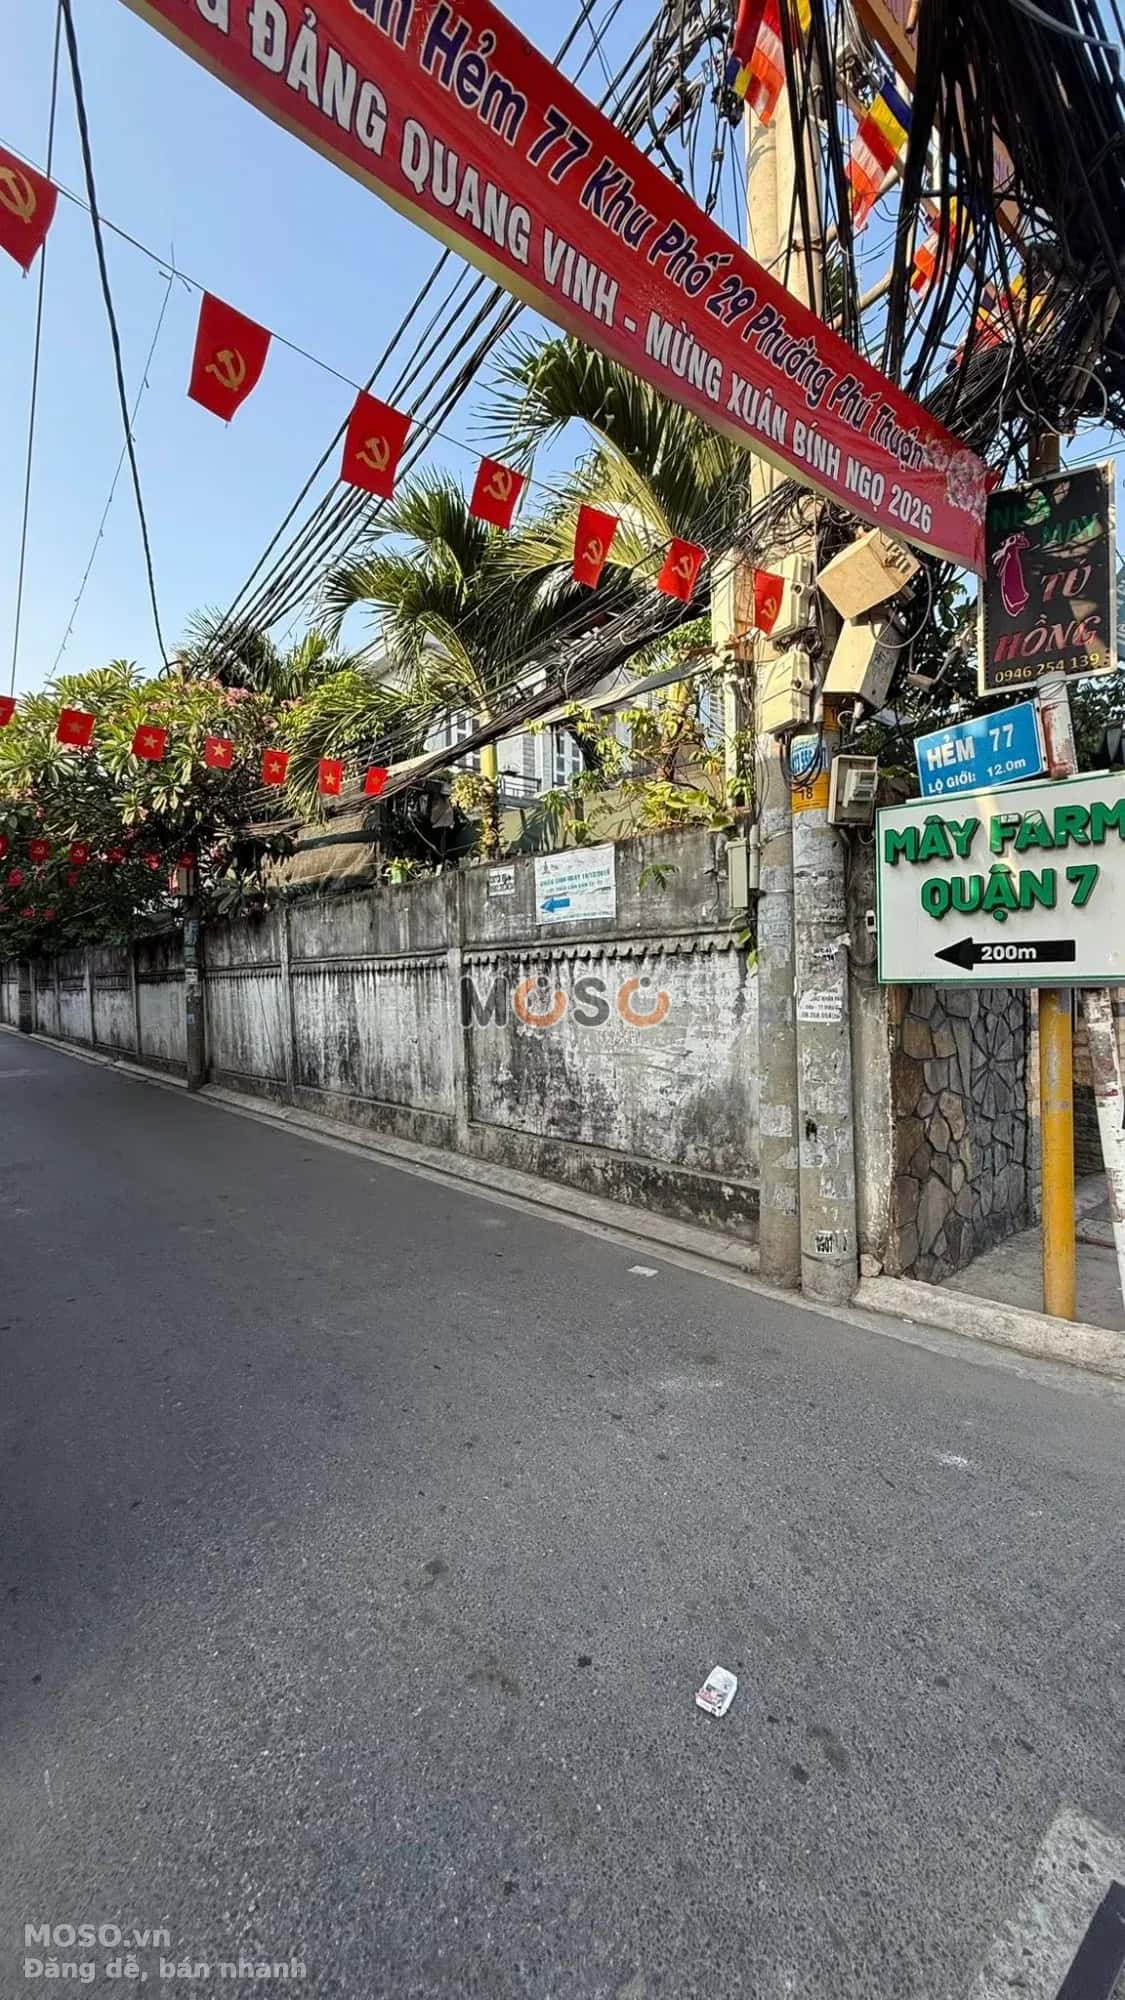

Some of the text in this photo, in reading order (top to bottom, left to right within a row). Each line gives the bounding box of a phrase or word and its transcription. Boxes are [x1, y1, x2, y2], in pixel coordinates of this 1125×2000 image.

[420, 1, 528, 146] Hẻm
[528, 105, 592, 184] 77
[580, 158, 656, 247] Khu
[648, 222, 733, 297] Phố
[705, 279, 756, 326] 29
[741, 303, 836, 409] Phường
[827, 373, 882, 429] Phú
[248, 0, 388, 156] ĐẢNG
[400, 118, 532, 264] QUANG
[542, 226, 621, 328] VINH
[644, 311, 723, 402] MỪNG
[726, 371, 789, 445] XUÂN
[792, 414, 841, 481] BÍNH
[845, 456, 886, 512] NGỌ
[888, 485, 934, 534] 2026
[1041, 558, 1092, 602] TÚ
[994, 614, 1101, 663] HỒNG
[995, 665, 1032, 683] 0946
[1071, 653, 1100, 669] 139
[926, 723, 1014, 771] HẺM 77
[800, 786, 813, 800] 18
[928, 778, 943, 794] LỘ
[986, 757, 1027, 778] 12.0m
[884, 799, 1125, 866] MÂY FARM
[921, 864, 1099, 922] QUẬN 7
[981, 945, 1037, 961] 200m
